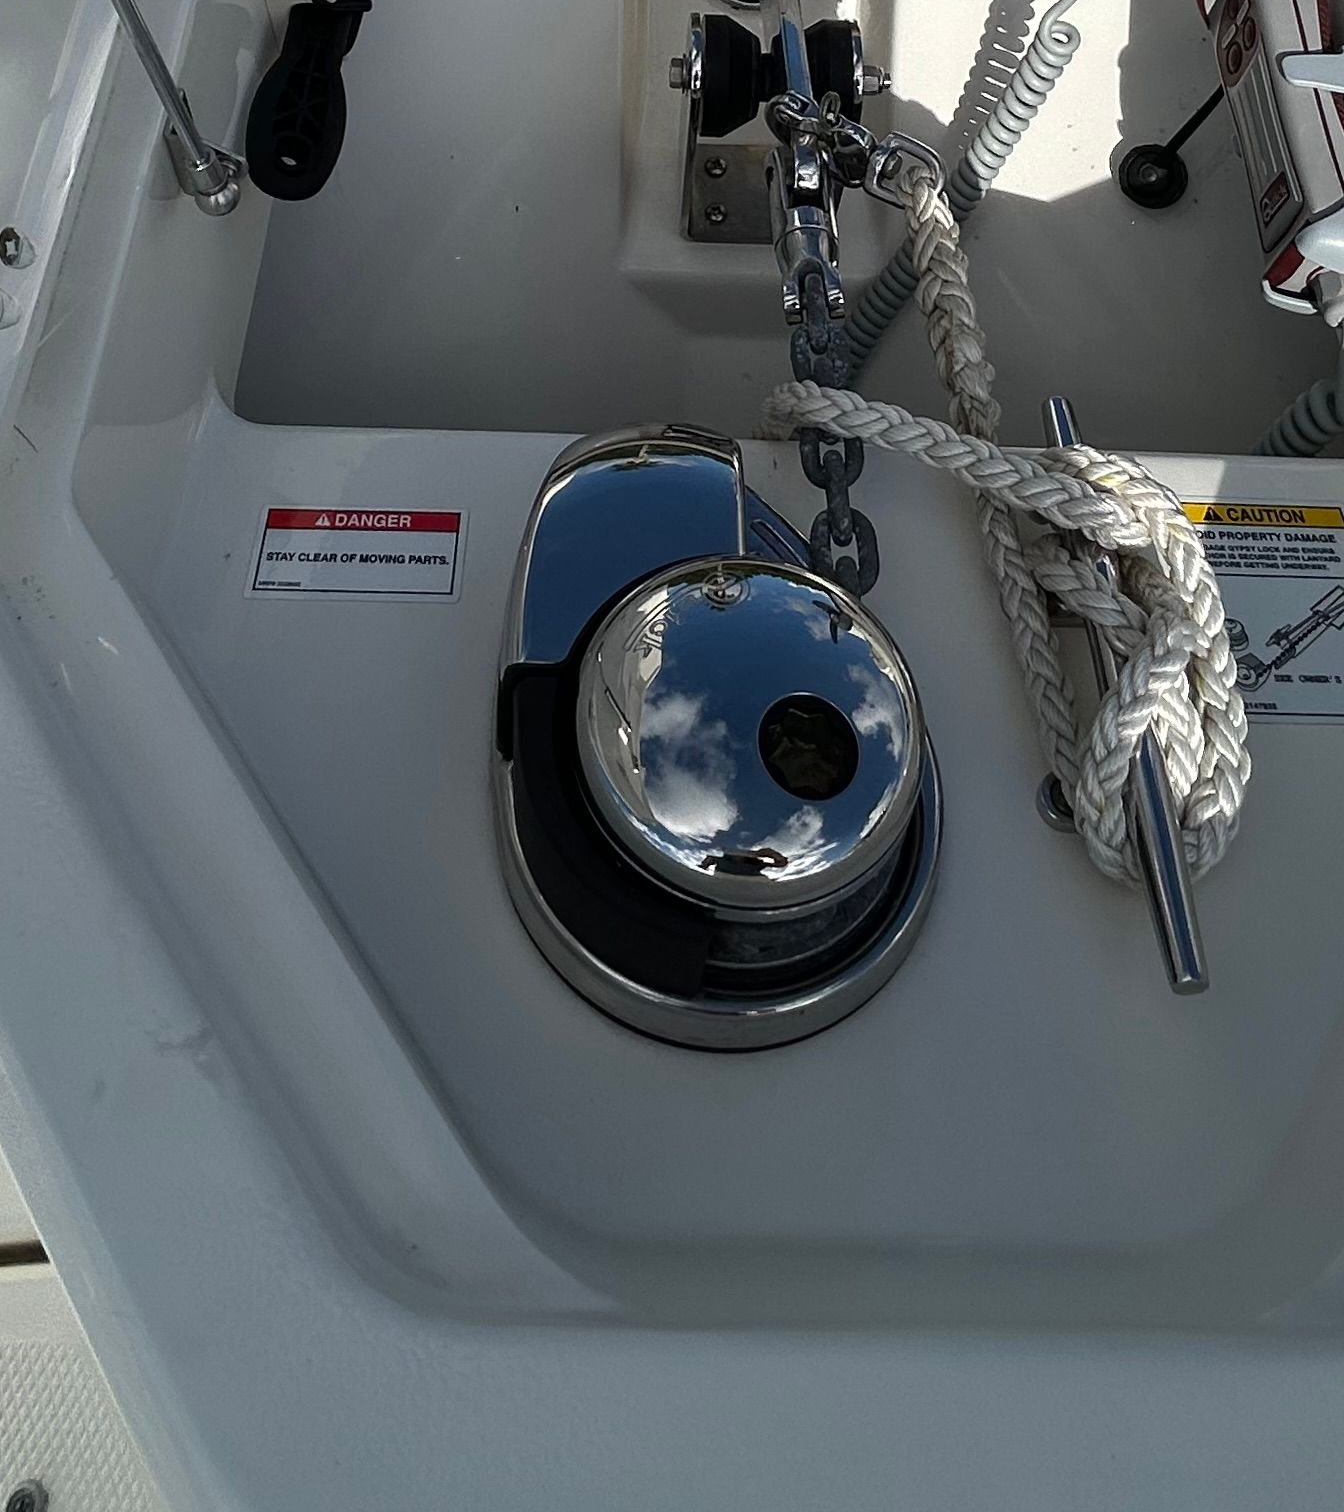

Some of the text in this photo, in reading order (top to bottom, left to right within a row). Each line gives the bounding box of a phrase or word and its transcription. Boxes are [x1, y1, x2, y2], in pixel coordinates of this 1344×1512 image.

[334, 513, 412, 528] DANGER
[1226, 508, 1306, 524] CAUTION
[1195, 530, 1337, 544] OID PROPERTY DAMAGE
[1257, 546, 1281, 554] LOCK
[1282, 546, 1301, 554] AND
[266, 551, 450, 566] STAY CLEAR OF MOVING PARTS.
[1279, 554, 1301, 562] WITH
